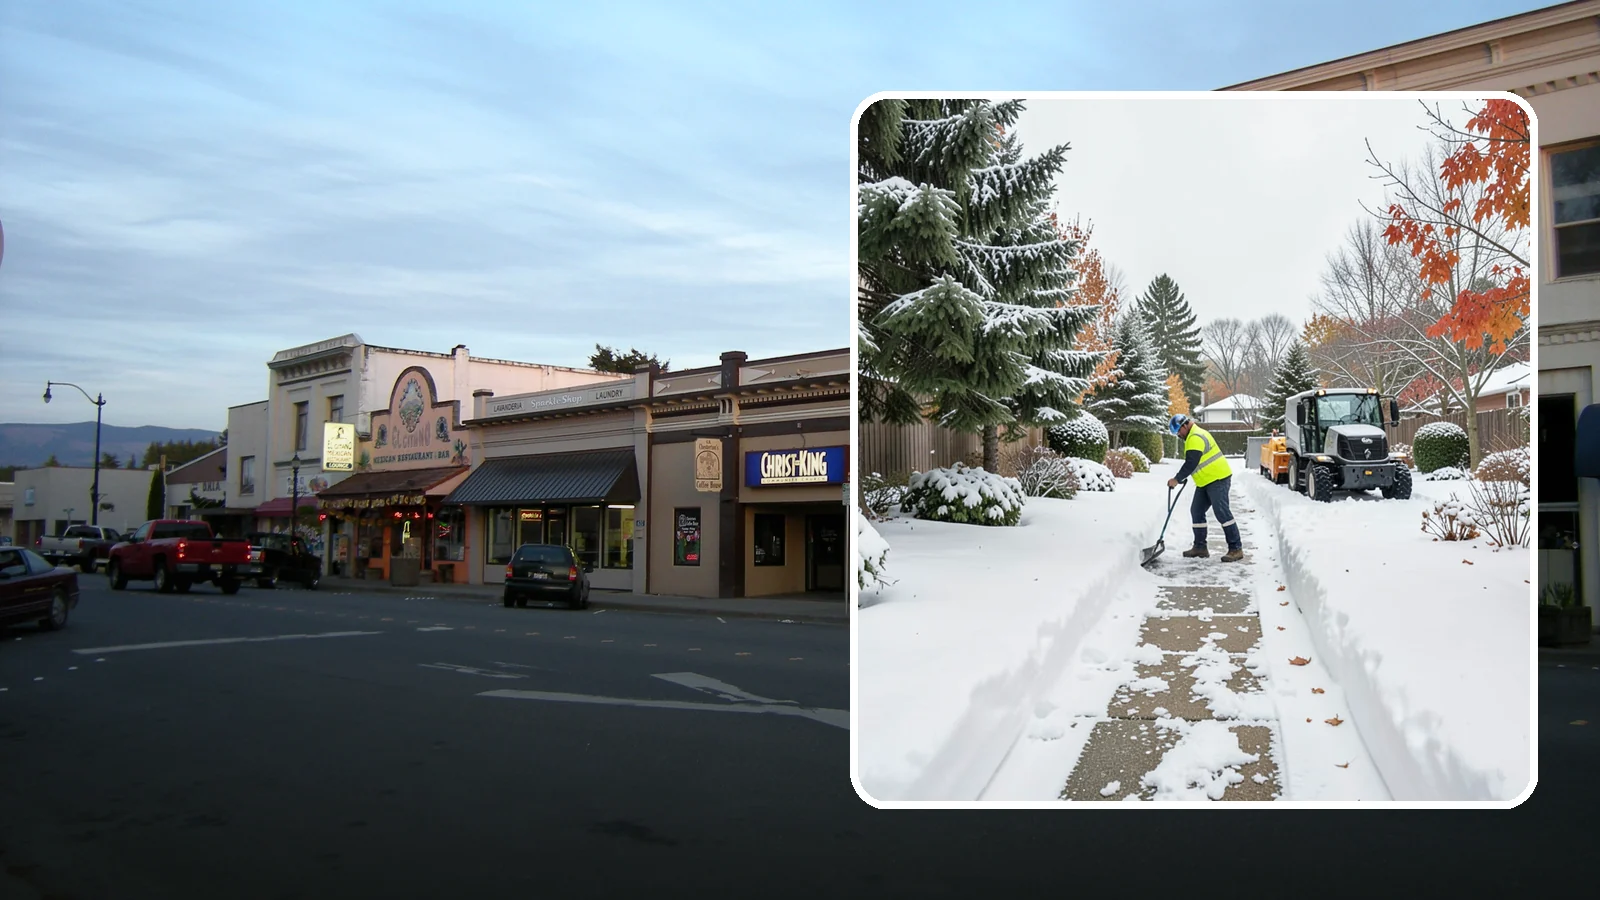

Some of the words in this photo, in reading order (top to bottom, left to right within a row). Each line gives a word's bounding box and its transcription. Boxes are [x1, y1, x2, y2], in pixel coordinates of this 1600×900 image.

[531, 397, 561, 408] Sparkle
[562, 394, 583, 404] Shop
[595, 389, 623, 400] LAUNDRY
[493, 402, 522, 412] LAVANDERIA
[374, 455, 396, 464] MEXICAN
[397, 451, 433, 462] RESTAURANT
[437, 450, 450, 459] BAR
[761, 452, 797, 478] CHRIST
[799, 450, 828, 476] KING
